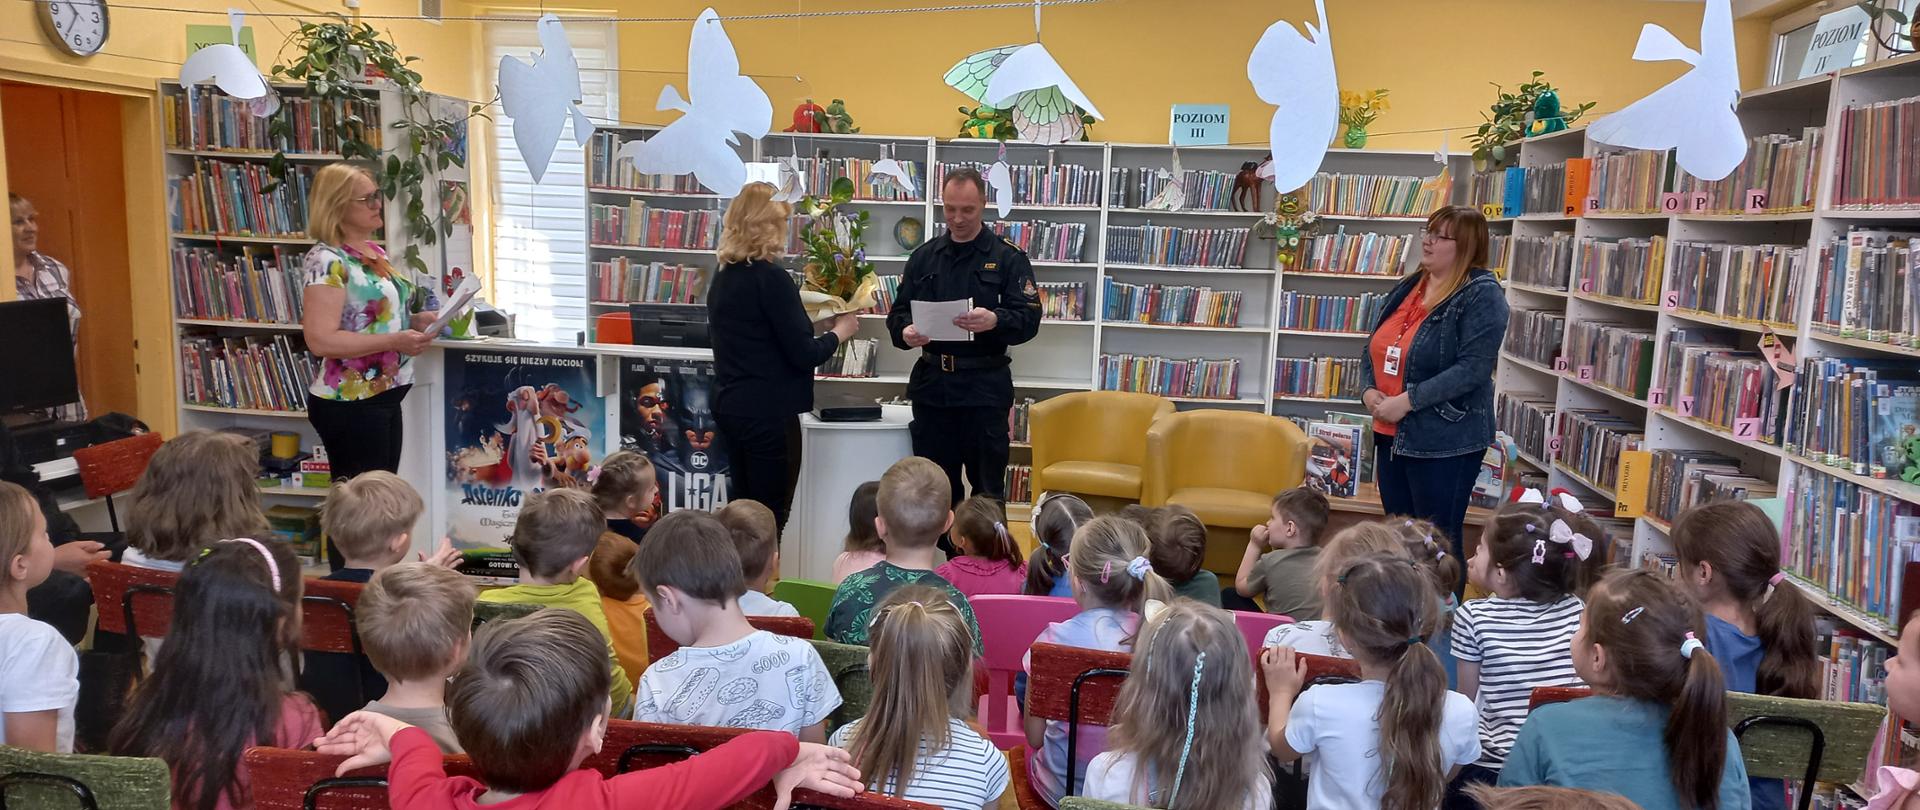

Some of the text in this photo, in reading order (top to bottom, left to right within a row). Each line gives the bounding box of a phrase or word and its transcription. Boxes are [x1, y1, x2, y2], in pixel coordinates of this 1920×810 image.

[91, 12, 99, 23] 3
[74, 34, 82, 46] 6
[1810, 22, 1862, 51] POZIOM
[1814, 55, 1832, 74] IV
[1174, 113, 1225, 124] POZIOM
[1191, 128, 1205, 138] III
[1590, 199, 1599, 210] B
[1666, 197, 1678, 210] O
[1696, 197, 1706, 210] P
[1751, 194, 1764, 209] R
[1483, 207, 1492, 216] O
[1495, 207, 1503, 216] P
[1566, 206, 1575, 215] P
[1667, 295, 1677, 308] S
[504, 355, 519, 366] SIĘ
[520, 357, 550, 367] NIEZŁY
[1557, 360, 1568, 371] D
[1580, 368, 1590, 379] E
[1653, 392, 1663, 404] T
[1683, 400, 1694, 413] V
[1737, 422, 1753, 437] Z
[1549, 438, 1560, 449] G
[691, 455, 708, 466] DC
[461, 484, 521, 507] Asteriks
[668, 471, 728, 513] LIGA
[1617, 502, 1629, 512] Prz
[488, 561, 513, 569] GOTOWI
[751, 649, 791, 675] GOOD
